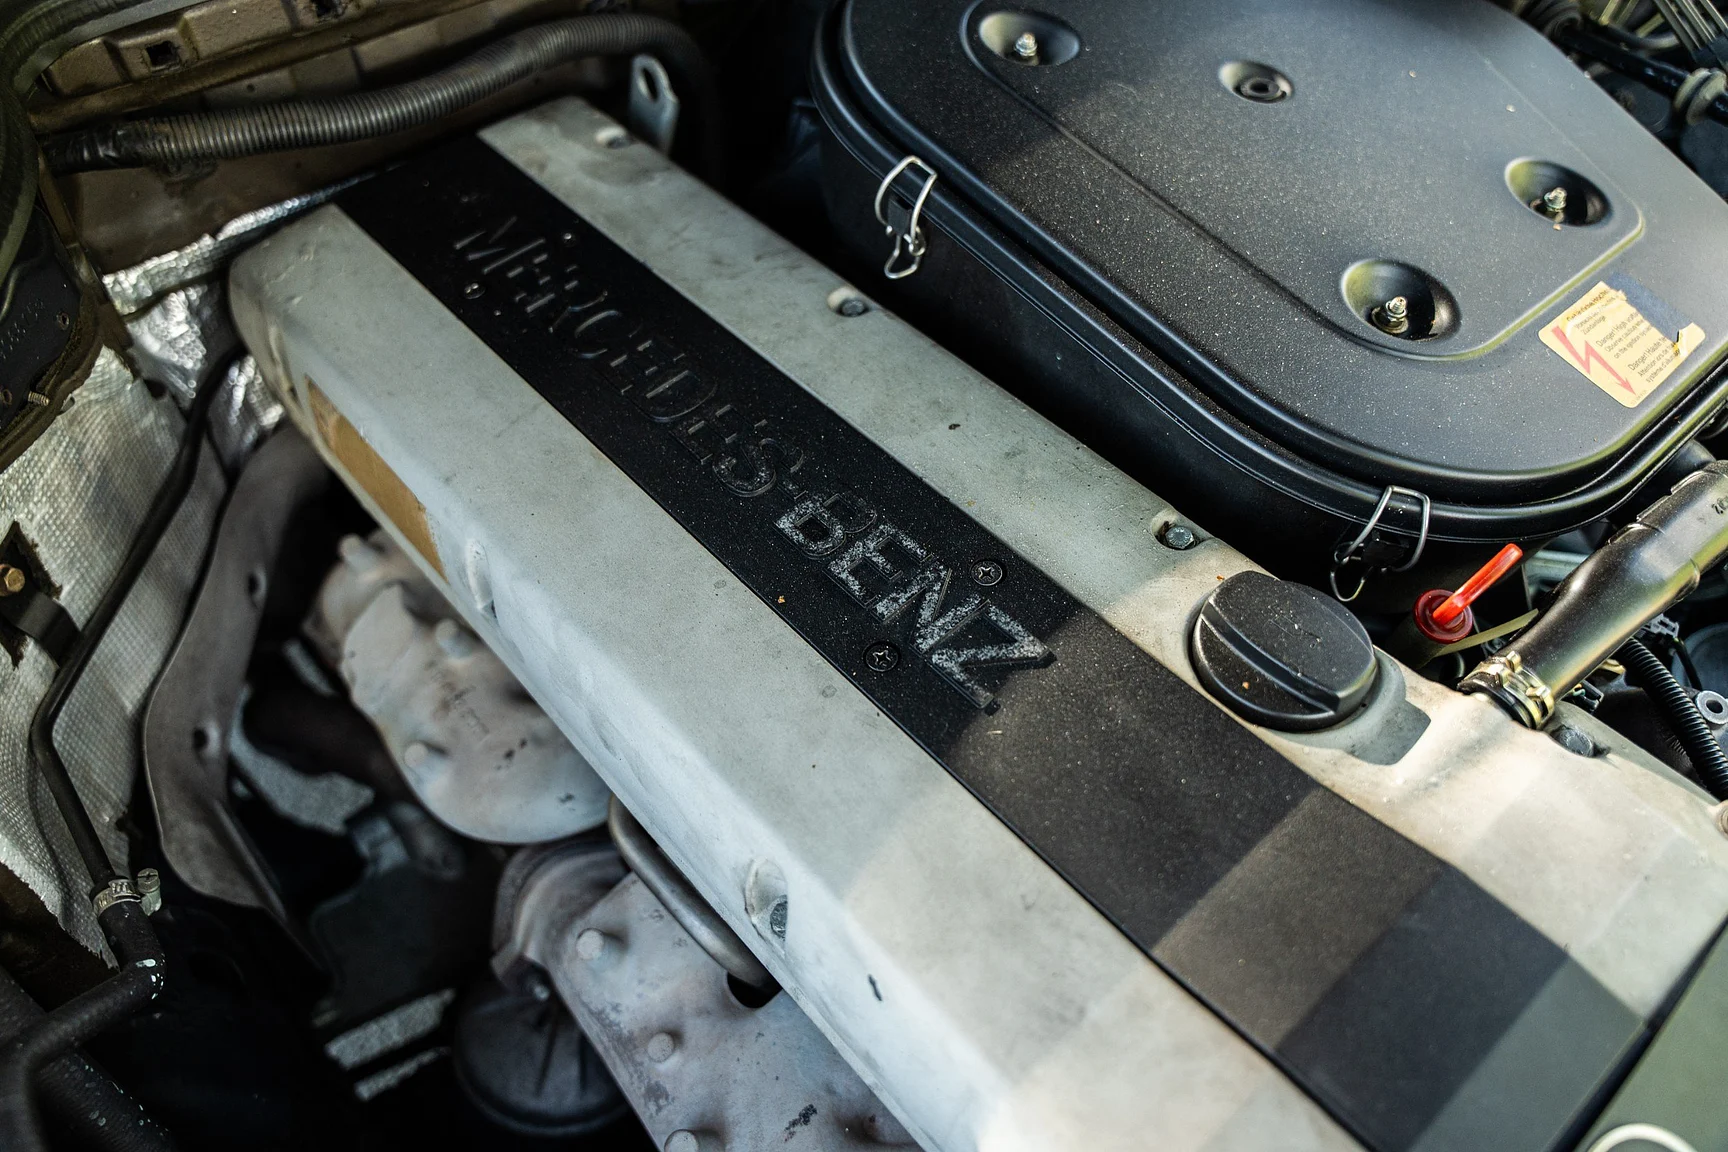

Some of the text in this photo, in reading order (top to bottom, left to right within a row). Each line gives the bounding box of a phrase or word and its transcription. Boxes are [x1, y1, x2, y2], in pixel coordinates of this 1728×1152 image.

[1594, 328, 1618, 347] Danger!
[1612, 319, 1629, 333] High
[1603, 336, 1623, 352] Observe
[1626, 351, 1650, 371] Danger!
[1644, 340, 1663, 355] Haute
[1636, 358, 1658, 377] Attention
[453, 214, 1056, 714] MERCEDES-BENZ
